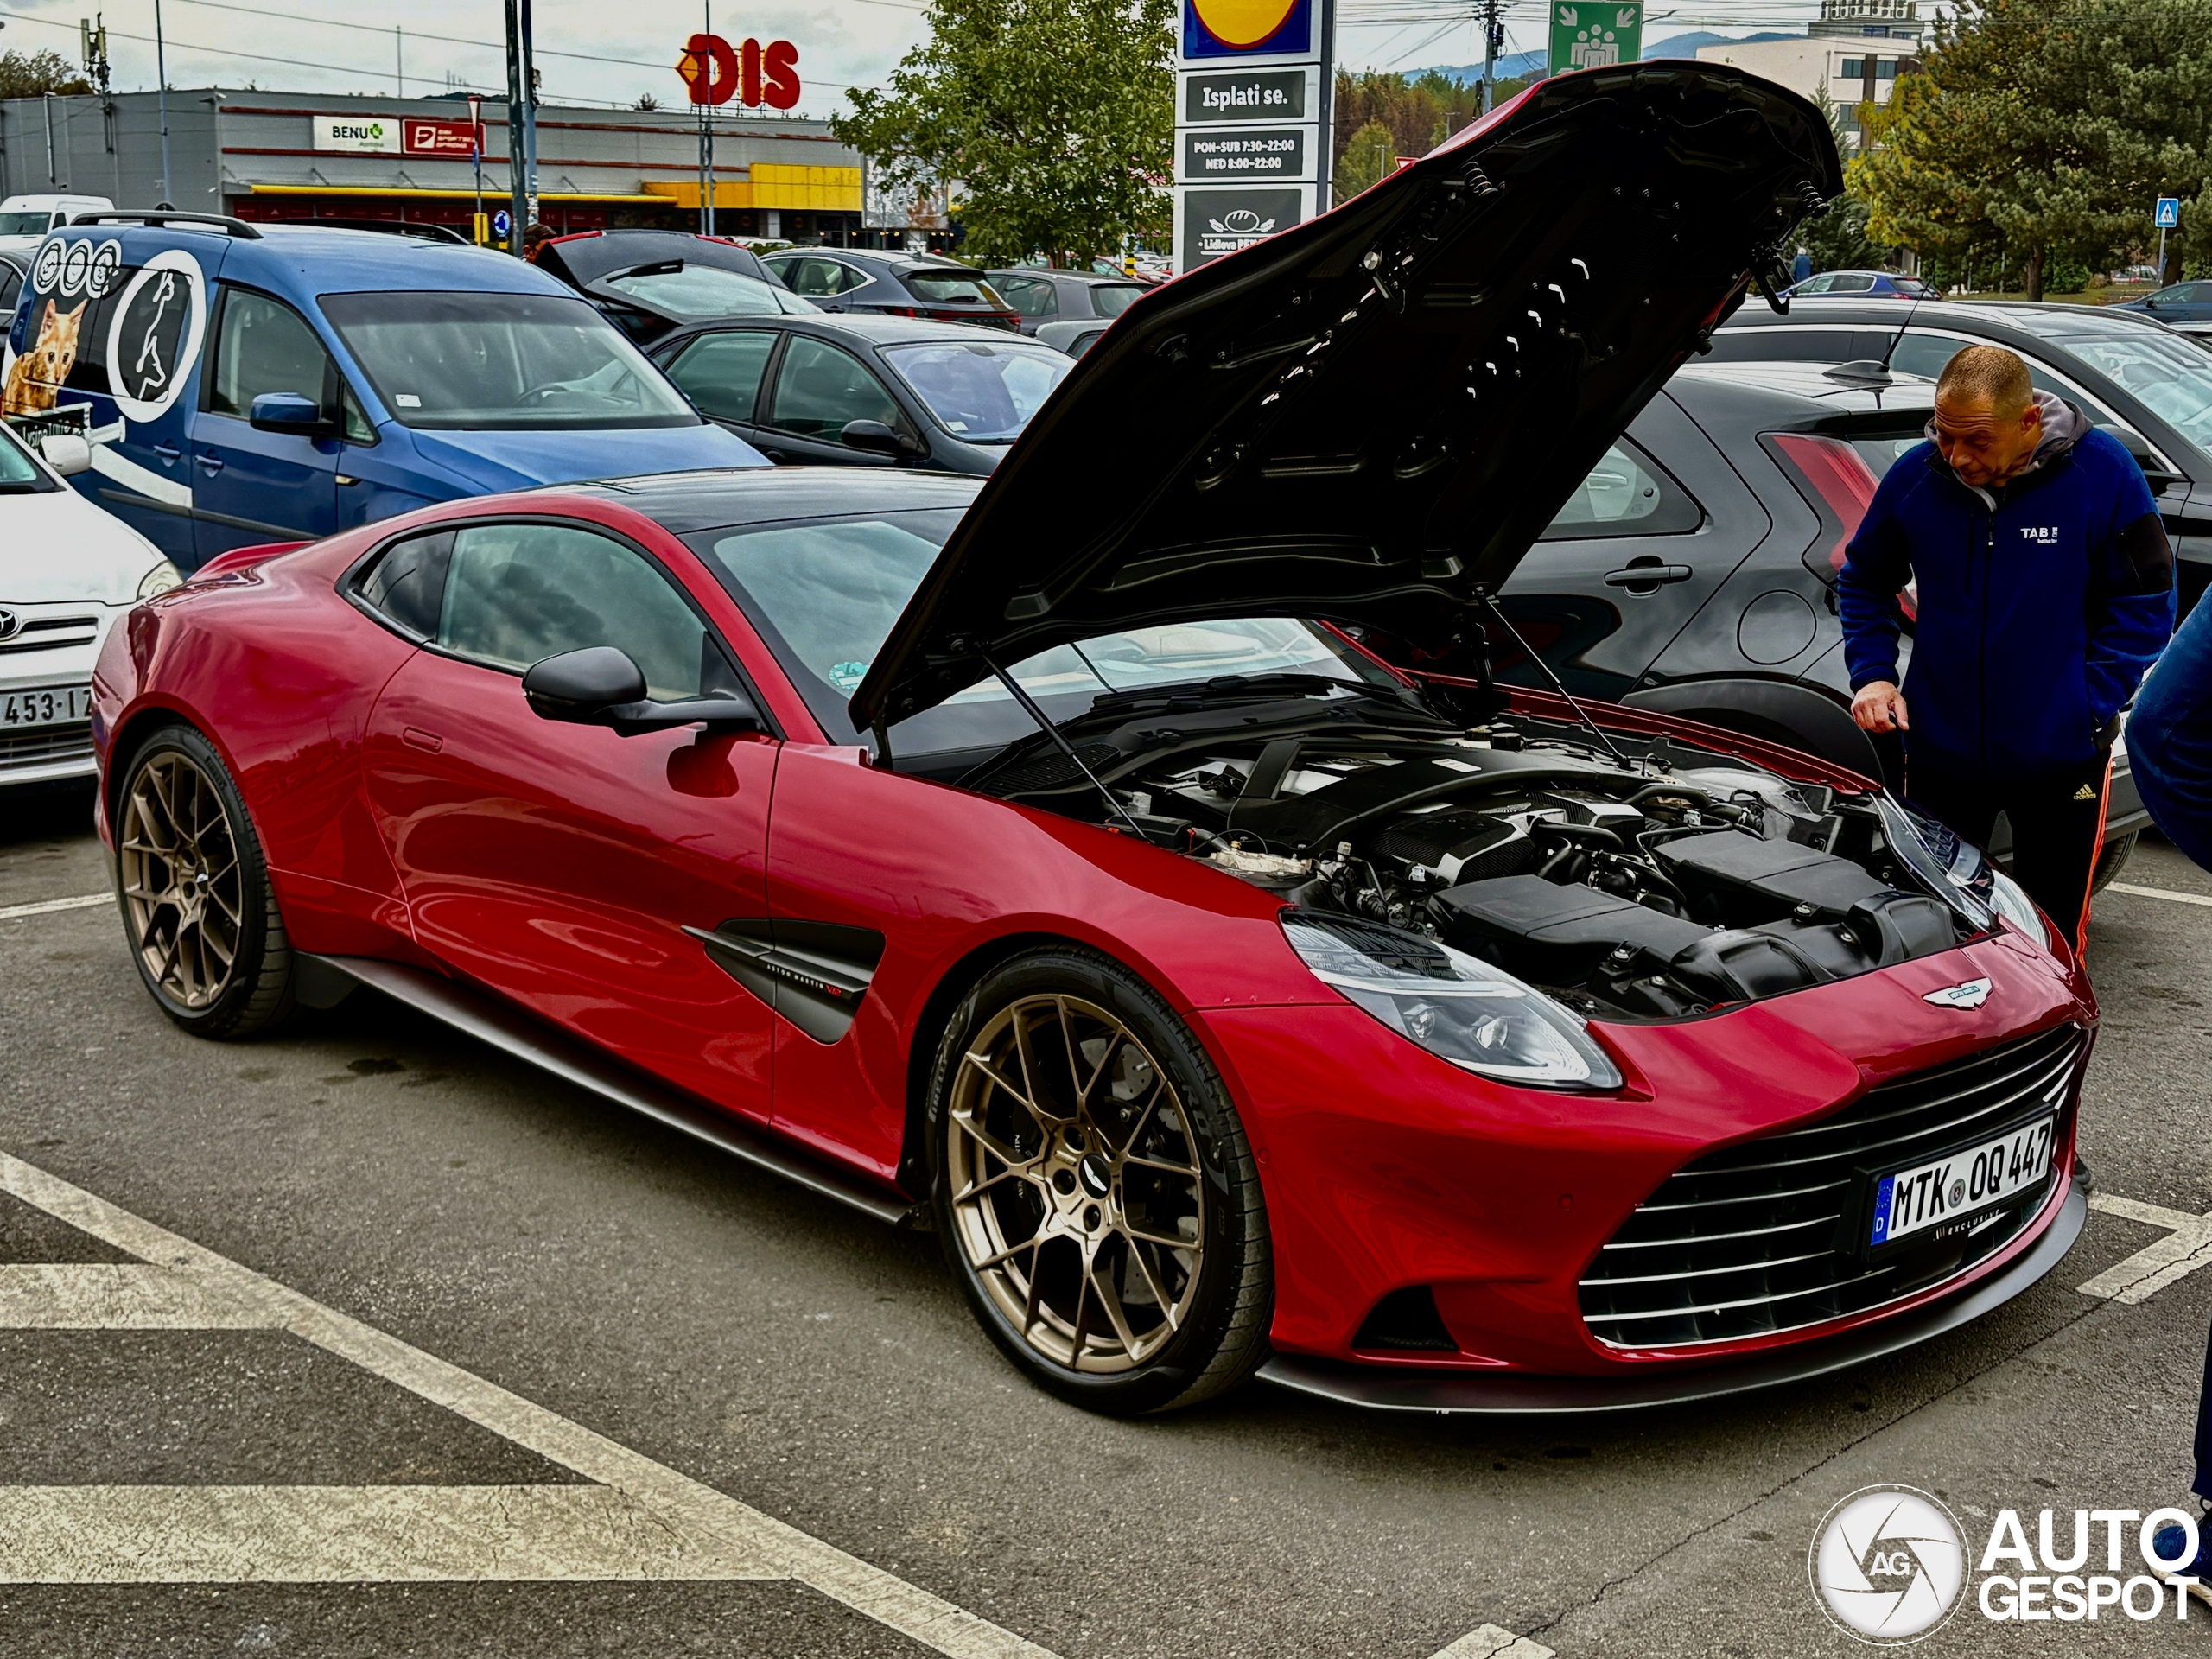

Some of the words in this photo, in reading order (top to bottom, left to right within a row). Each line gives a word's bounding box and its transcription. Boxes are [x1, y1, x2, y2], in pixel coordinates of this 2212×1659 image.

[687, 34, 801, 110] DIS
[1202, 84, 1260, 111] Isplati
[1263, 89, 1288, 105] se.
[332, 125, 369, 139] BENU
[1194, 141, 1241, 153] PON-SUB
[1205, 158, 1227, 170] NED
[1204, 238, 1237, 250] Lidlova
[2020, 527, 2049, 539] TAB
[1891, 1163, 1952, 1231] MTK
[1969, 1144, 2005, 1202] OQ
[2007, 1123, 2050, 1185] 447
[1875, 1217, 1884, 1233] D
